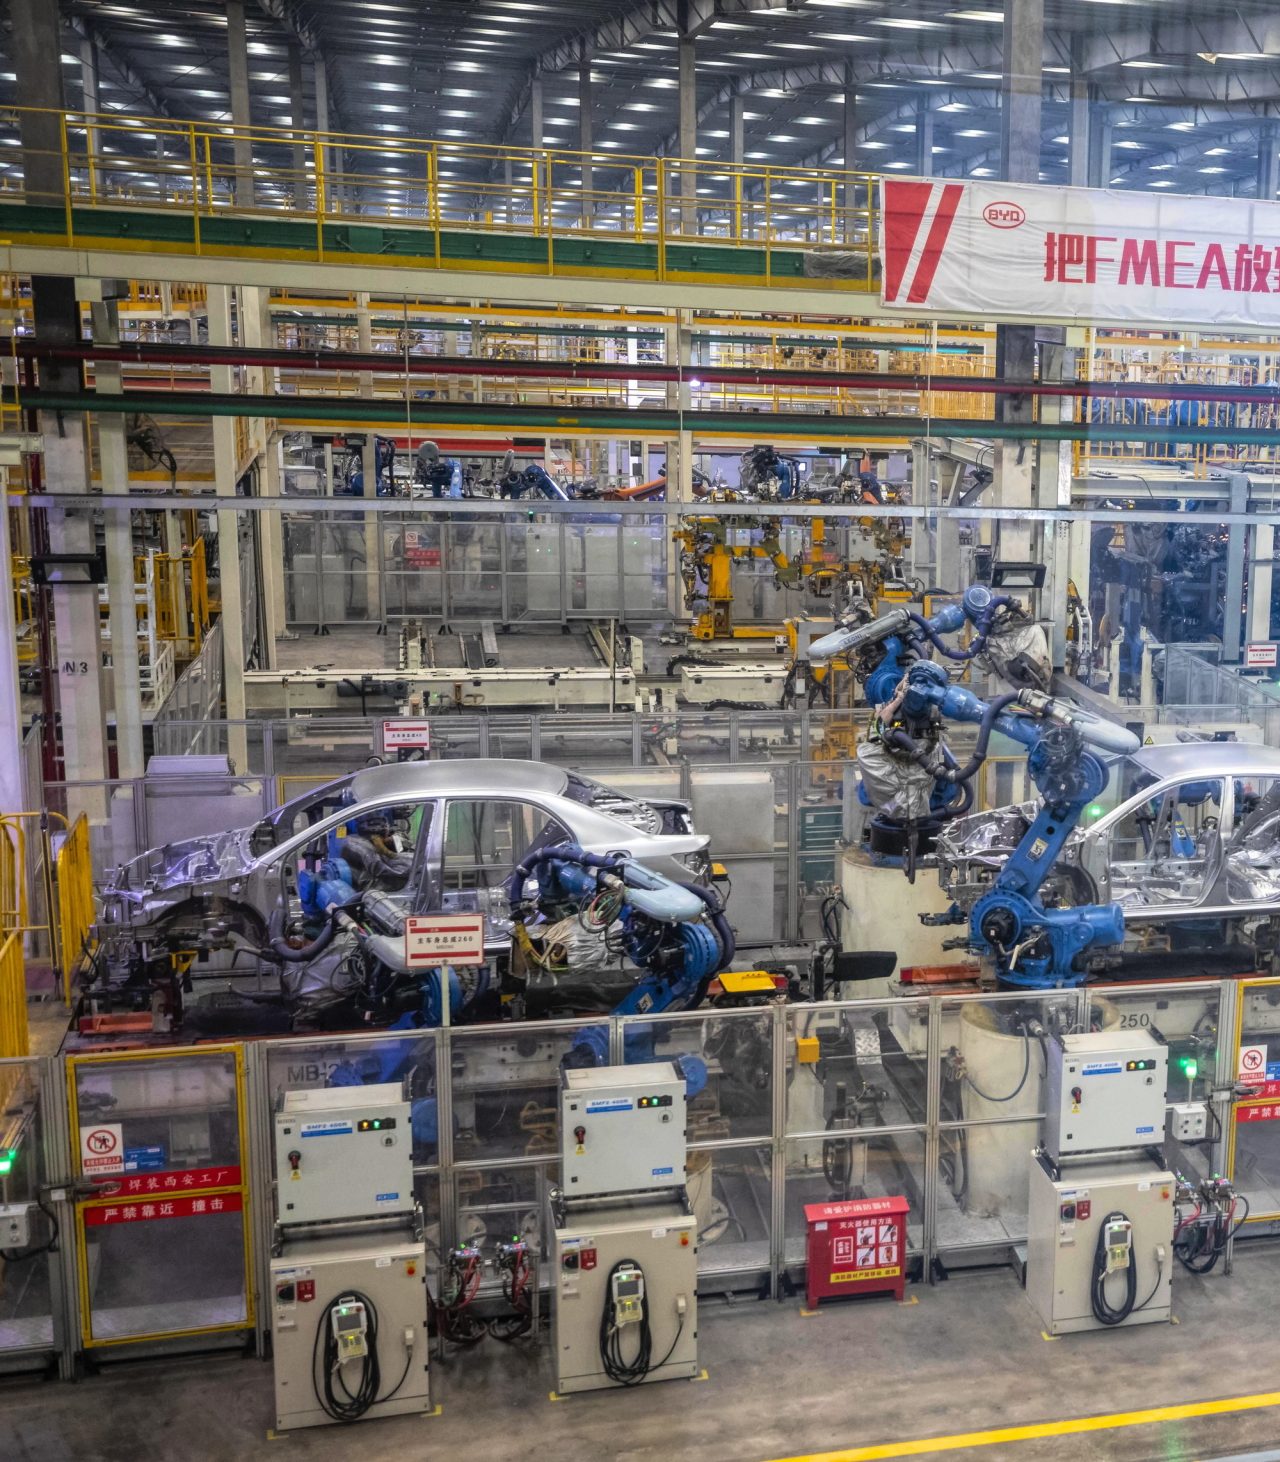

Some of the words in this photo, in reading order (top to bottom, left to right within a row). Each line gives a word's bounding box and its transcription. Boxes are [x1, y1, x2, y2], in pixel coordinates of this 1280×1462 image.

[988, 209, 1020, 222] BYD
[128, 1171, 228, 1191] 焊装西安工厂
[104, 1202, 174, 1221] 严禁靠近
